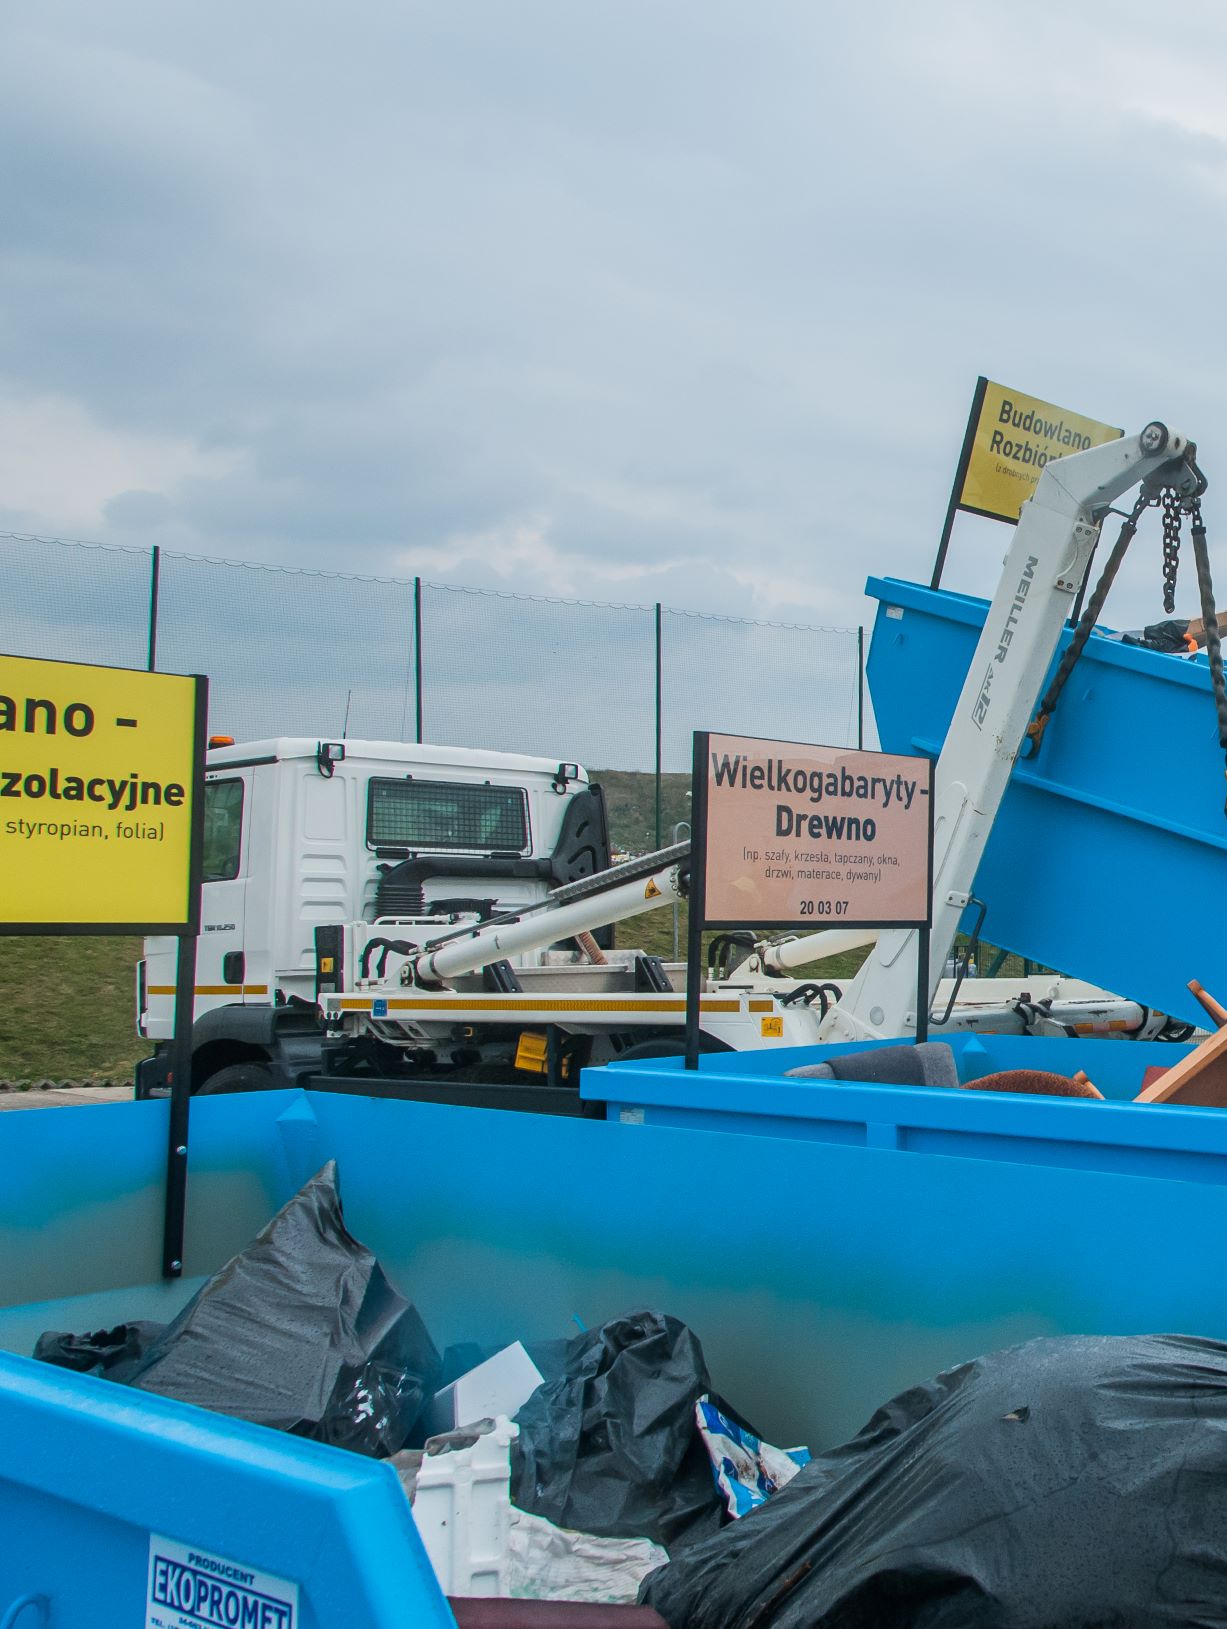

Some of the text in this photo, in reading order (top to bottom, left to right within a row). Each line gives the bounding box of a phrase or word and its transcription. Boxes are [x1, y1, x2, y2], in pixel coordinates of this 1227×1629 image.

[998, 400, 1091, 450] Budowlano
[990, 430, 1063, 469] Rozbió
[994, 555, 1038, 664] MEILLER
[5, 818, 164, 841] styropian, folia)
[775, 804, 877, 842] Drewno
[743, 846, 900, 867] (np. szafy, krzesła, tapczany, okna,
[765, 867, 881, 884] drzwi, materace, dywany)
[799, 900, 849, 915] 20 03 07
[188, 1552, 255, 1585] PRODUCENT
[155, 1560, 288, 1629] EKOPROMET
